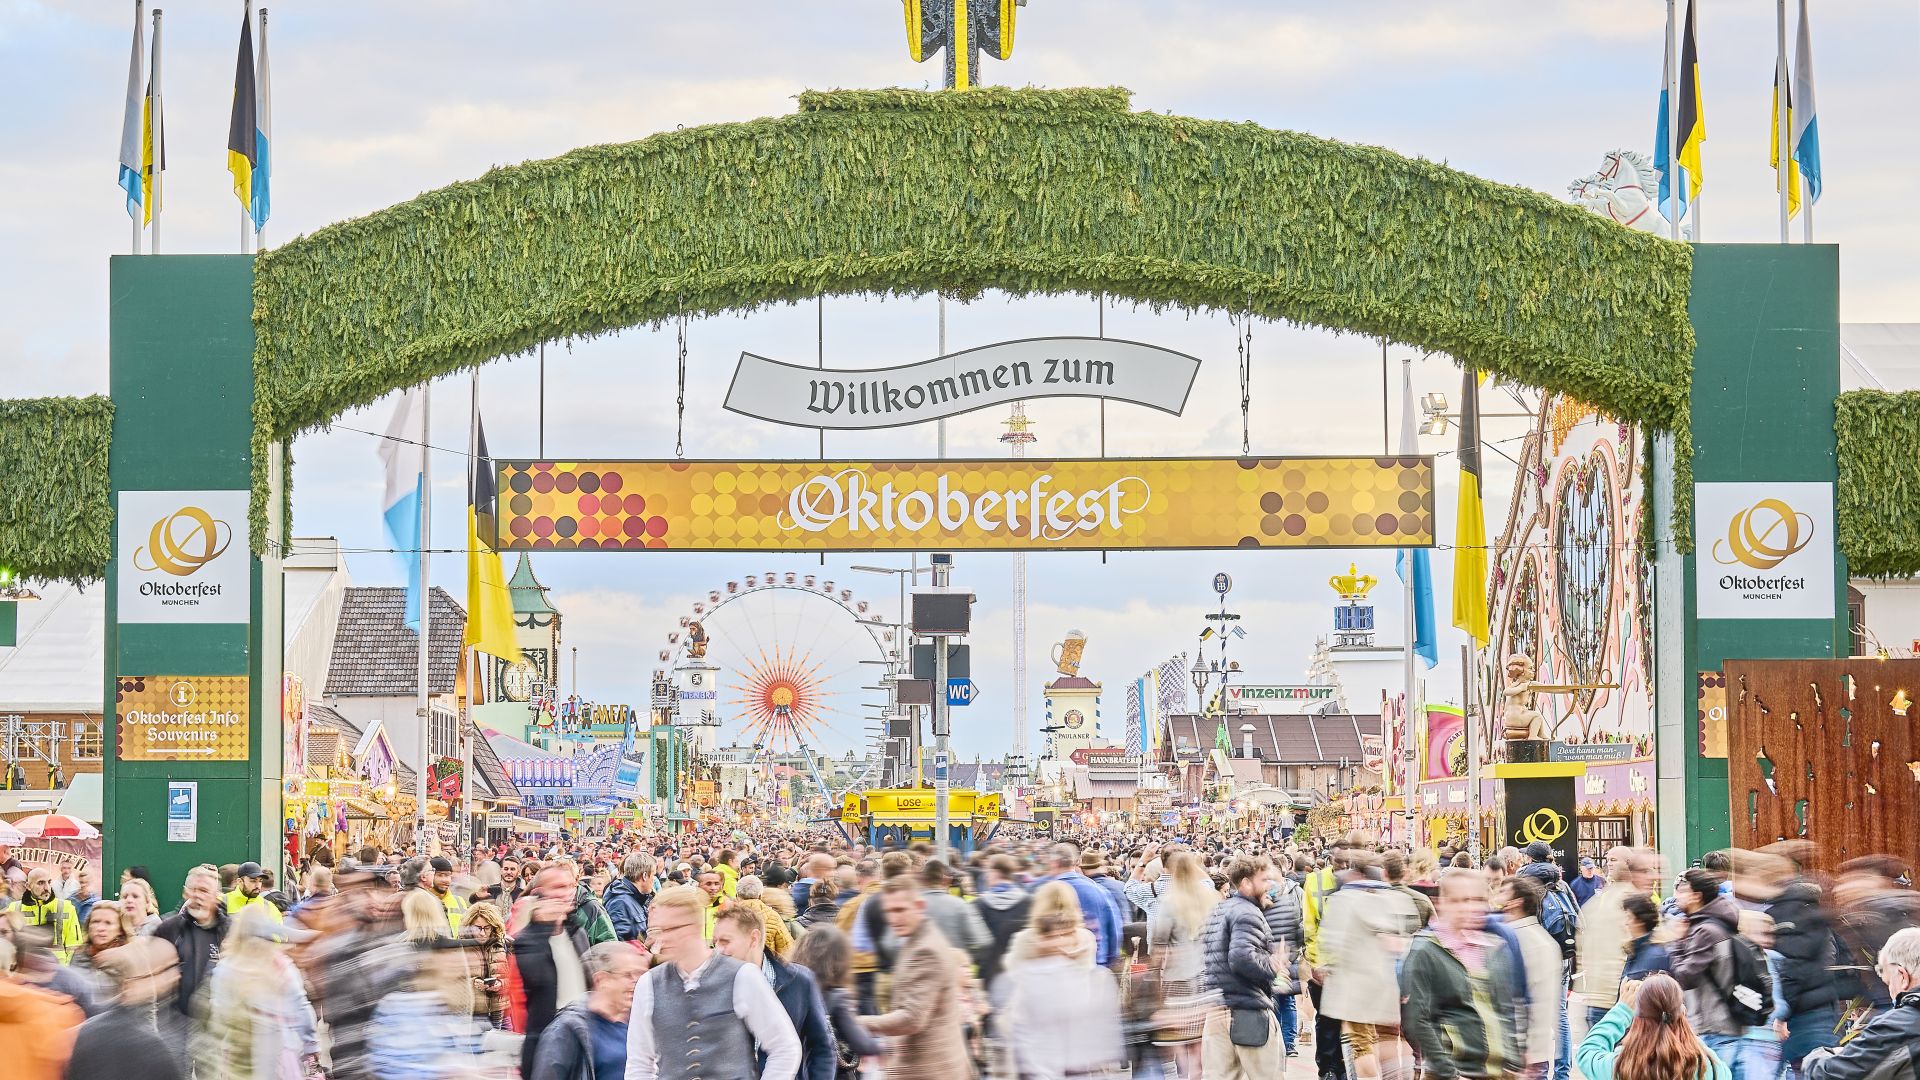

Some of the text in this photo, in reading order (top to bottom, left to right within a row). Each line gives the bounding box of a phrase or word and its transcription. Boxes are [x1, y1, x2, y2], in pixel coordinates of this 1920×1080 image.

[805, 357, 1116, 416] Willkommen zum
[777, 469, 1151, 541] Oktoberfest
[140, 581, 222, 597] Oktoberfest
[1719, 575, 1805, 591] Oktoberfest
[949, 684, 969, 700] WC
[1230, 685, 1333, 699] vinzenzmurr
[126, 710, 239, 727] Oktoberfest Info
[147, 727, 218, 742] Souvenirs
[1557, 746, 1575, 755] Dort
[1576, 746, 1596, 754] kann
[1603, 751, 1626, 760] muß!
[896, 797, 921, 807] Lose
